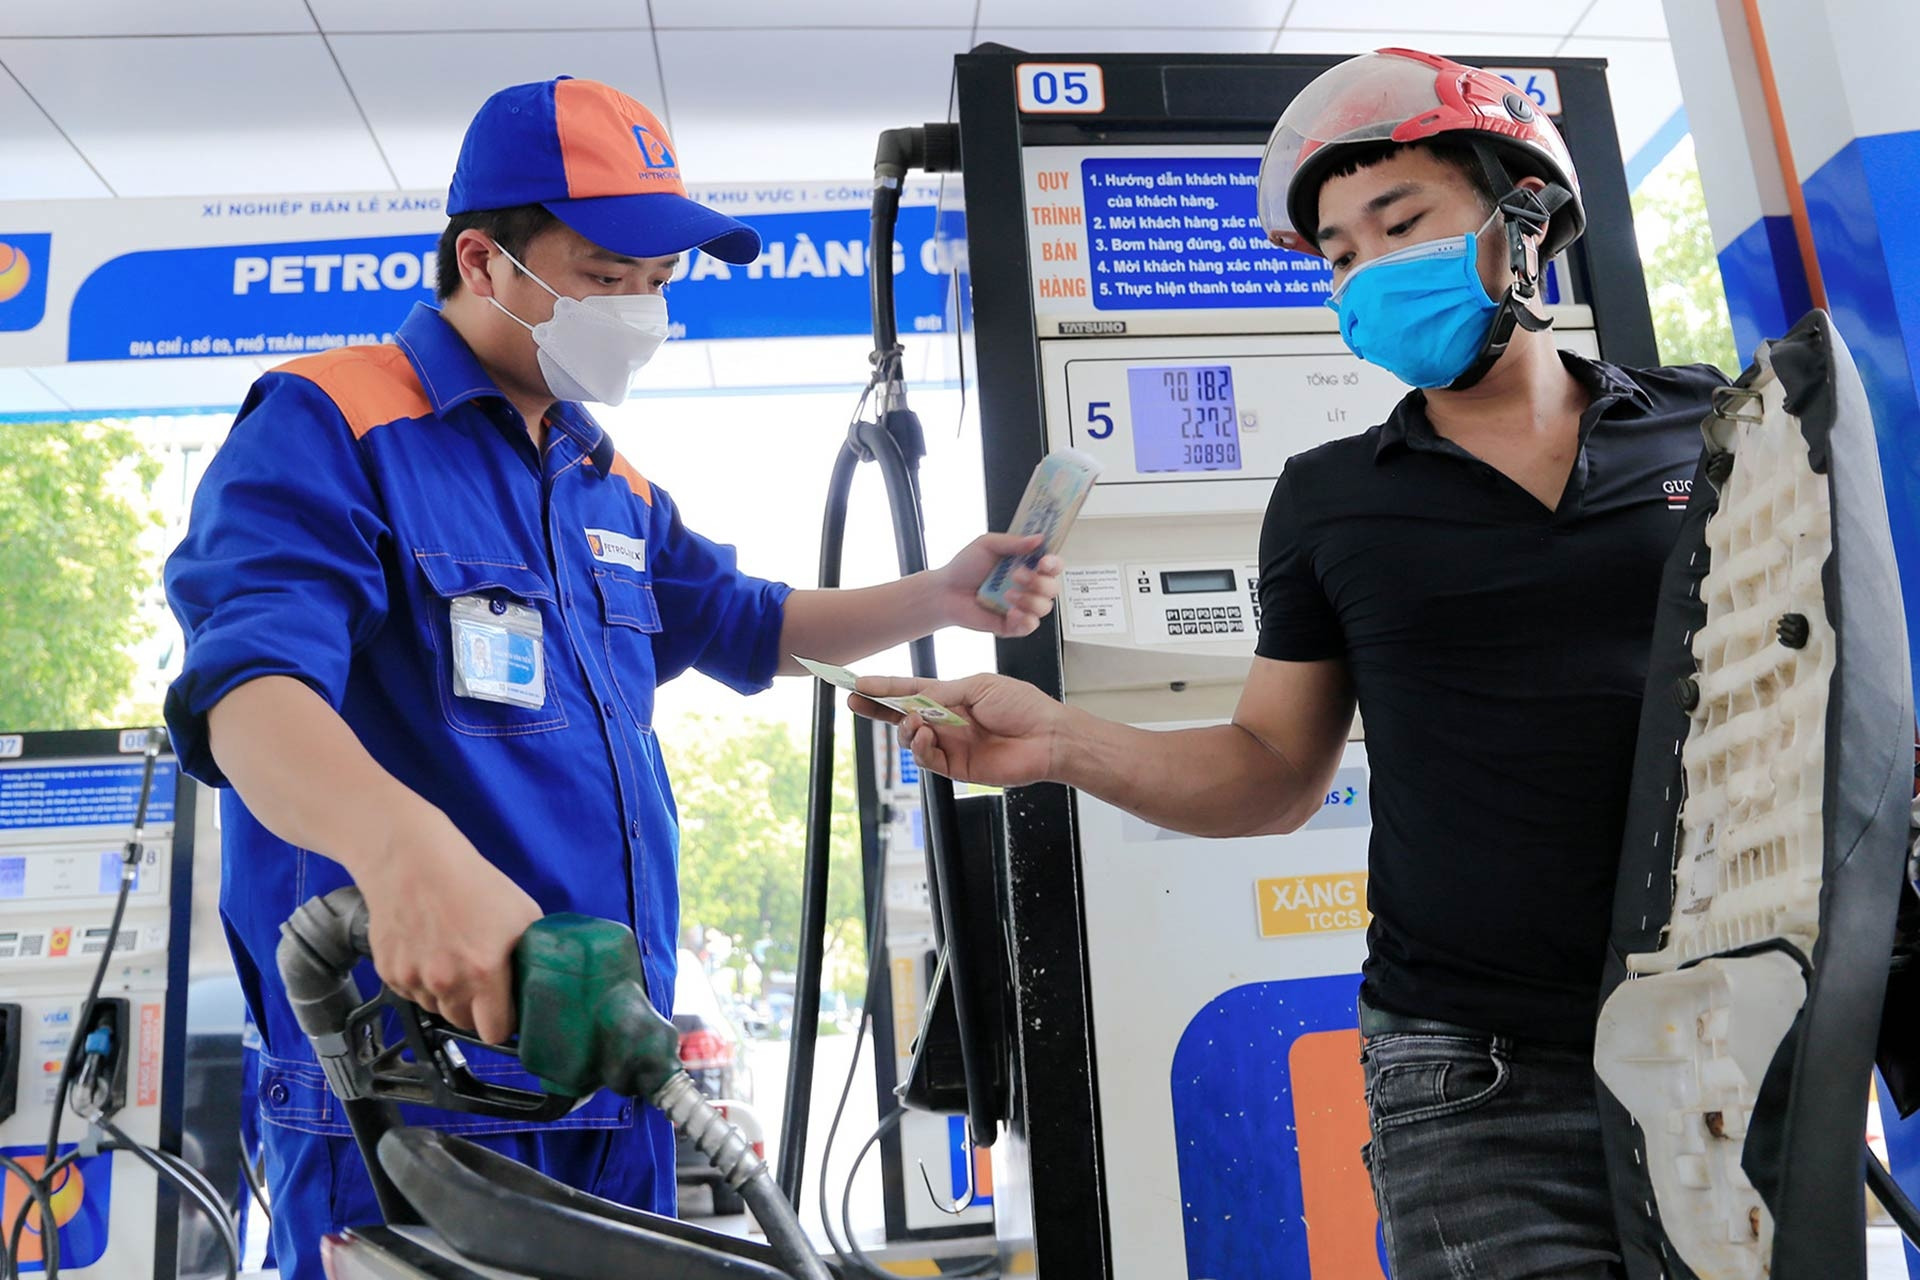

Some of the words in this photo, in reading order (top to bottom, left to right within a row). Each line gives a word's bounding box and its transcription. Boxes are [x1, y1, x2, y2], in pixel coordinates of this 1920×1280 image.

[1032, 71, 1089, 105] 05
[1037, 171, 1069, 192] QUY
[1090, 174, 1102, 187] 1.
[1105, 173, 1154, 189] Hướng
[1156, 171, 1183, 187] dẫn
[1185, 173, 1227, 186] khách
[309, 198, 350, 214] BÁN
[707, 190, 748, 203] KHU
[1107, 194, 1133, 208] của
[1135, 195, 1177, 208] khách
[1180, 194, 1219, 209] hàng.
[1031, 203, 1083, 226] TRÌNH
[1093, 217, 1106, 229] 2.
[1109, 216, 1136, 229] Mời
[1139, 216, 1181, 229] khách
[1184, 216, 1219, 231] hàng
[1221, 215, 1247, 228] xác
[1042, 238, 1078, 262] BÁN
[1095, 239, 1108, 251] 3.
[1111, 238, 1146, 251] Bơm
[1148, 238, 1184, 253] hàng
[1186, 237, 1226, 253] đúng,
[1228, 237, 1247, 250] đủ
[1097, 260, 1110, 273] 4.
[1113, 260, 1141, 273] Mời
[1143, 260, 1186, 272] khách
[1188, 259, 1224, 274] hàng
[1226, 258, 1251, 271] xác
[1254, 258, 1288, 274] nhận
[1291, 258, 1321, 271] màn
[1039, 275, 1087, 298] HÀNG
[1100, 283, 1112, 296] 5.
[1115, 282, 1153, 298] Thực
[1155, 281, 1186, 297] hiện
[1188, 281, 1229, 294] thanh
[1231, 280, 1262, 293] toán
[1265, 280, 1282, 293] và
[1284, 280, 1310, 293] xác
[1060, 322, 1125, 333] TATSUNO
[1163, 370, 1229, 402] 70182
[1342, 372, 1359, 386] SỐ
[1087, 402, 1114, 440] 5
[1181, 406, 1233, 439] 2.272
[1183, 443, 1236, 465] 30890
[1662, 480, 1694, 493] GUC
[1166, 609, 1179, 620] P1
[1184, 623, 1197, 633] P7
[1272, 880, 1357, 912] XĂNG
[1305, 909, 1363, 930] TCCS
